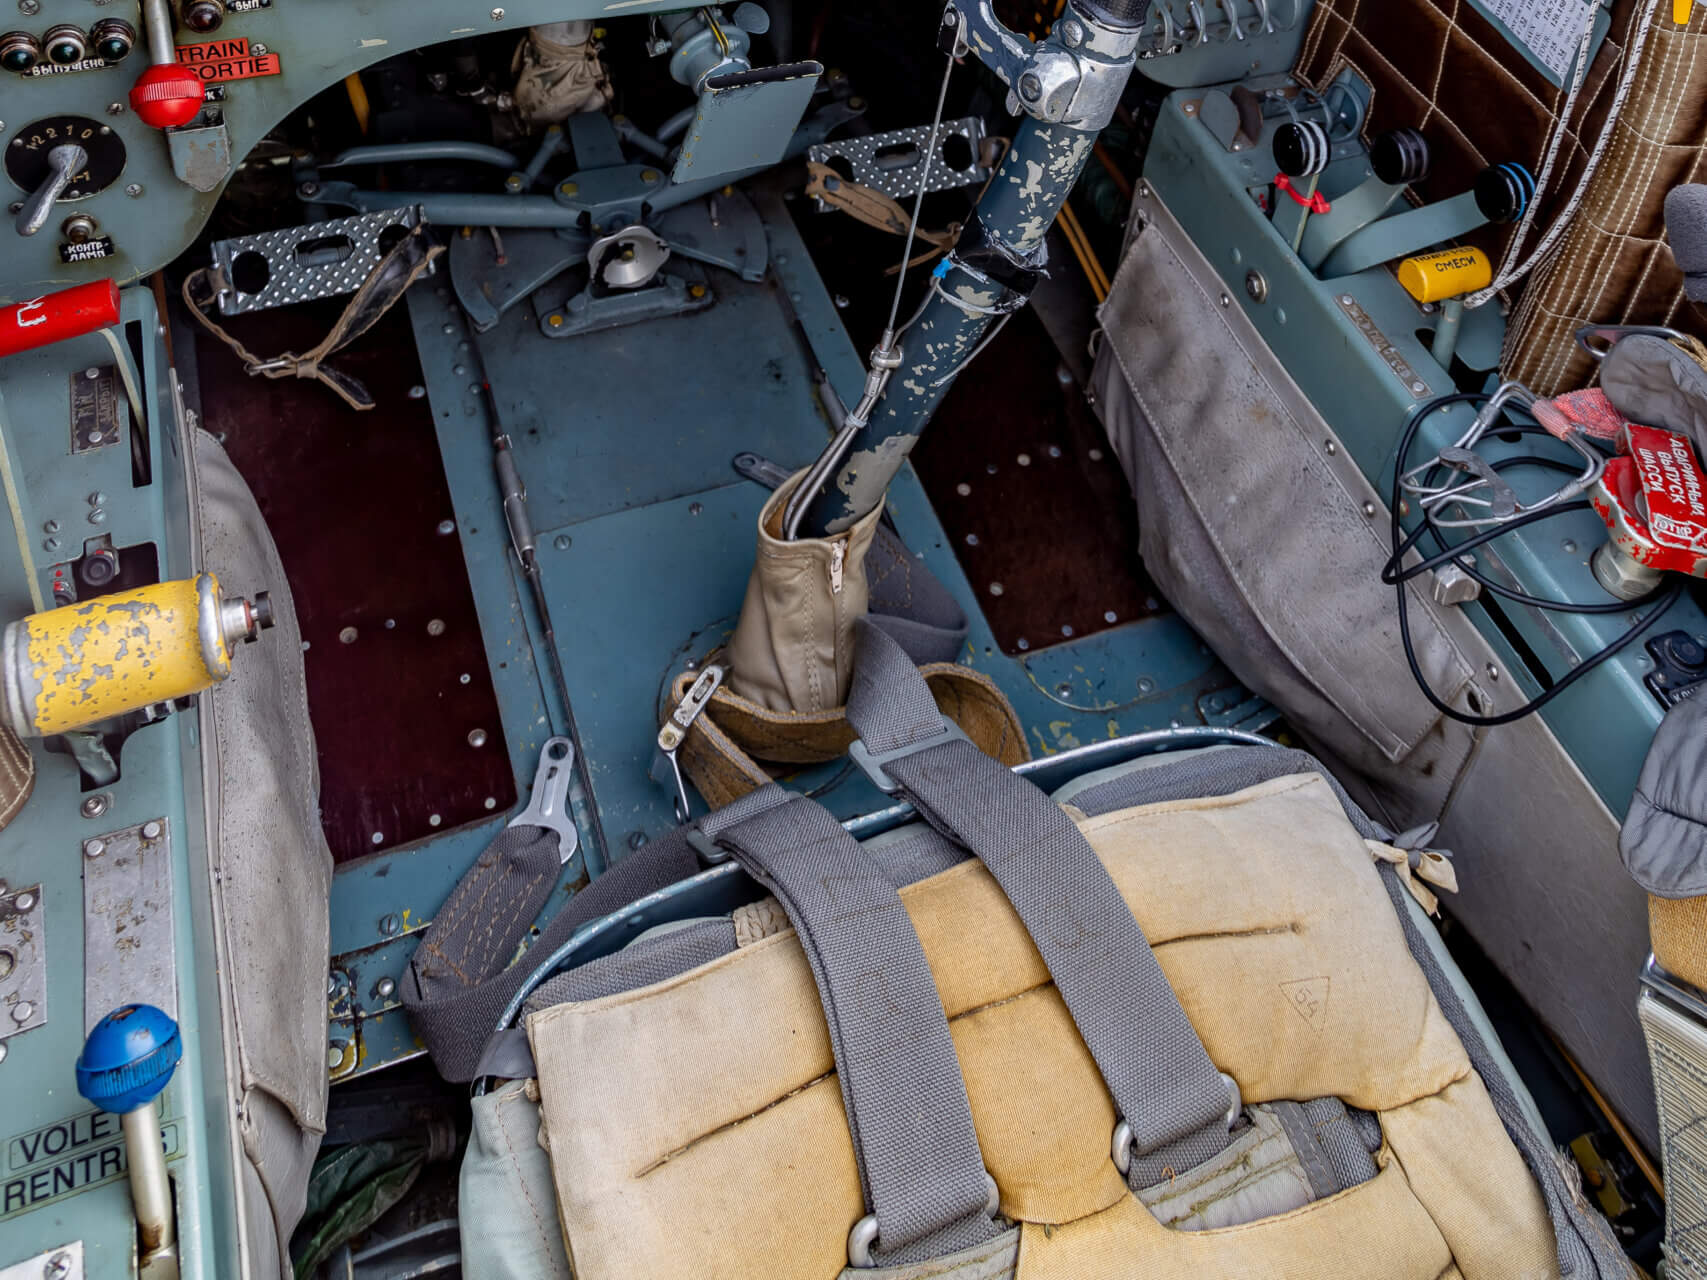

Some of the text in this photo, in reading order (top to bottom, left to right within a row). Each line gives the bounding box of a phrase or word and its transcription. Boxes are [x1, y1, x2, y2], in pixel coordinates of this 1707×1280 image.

[176, 41, 245, 62] TRAIN
[1435, 256, 1476, 272] СМЕСИ
[1639, 447, 1668, 493] ШАССИ
[1657, 451, 1686, 505] ВЫПУСК
[20, 1111, 123, 1163] VOLE
